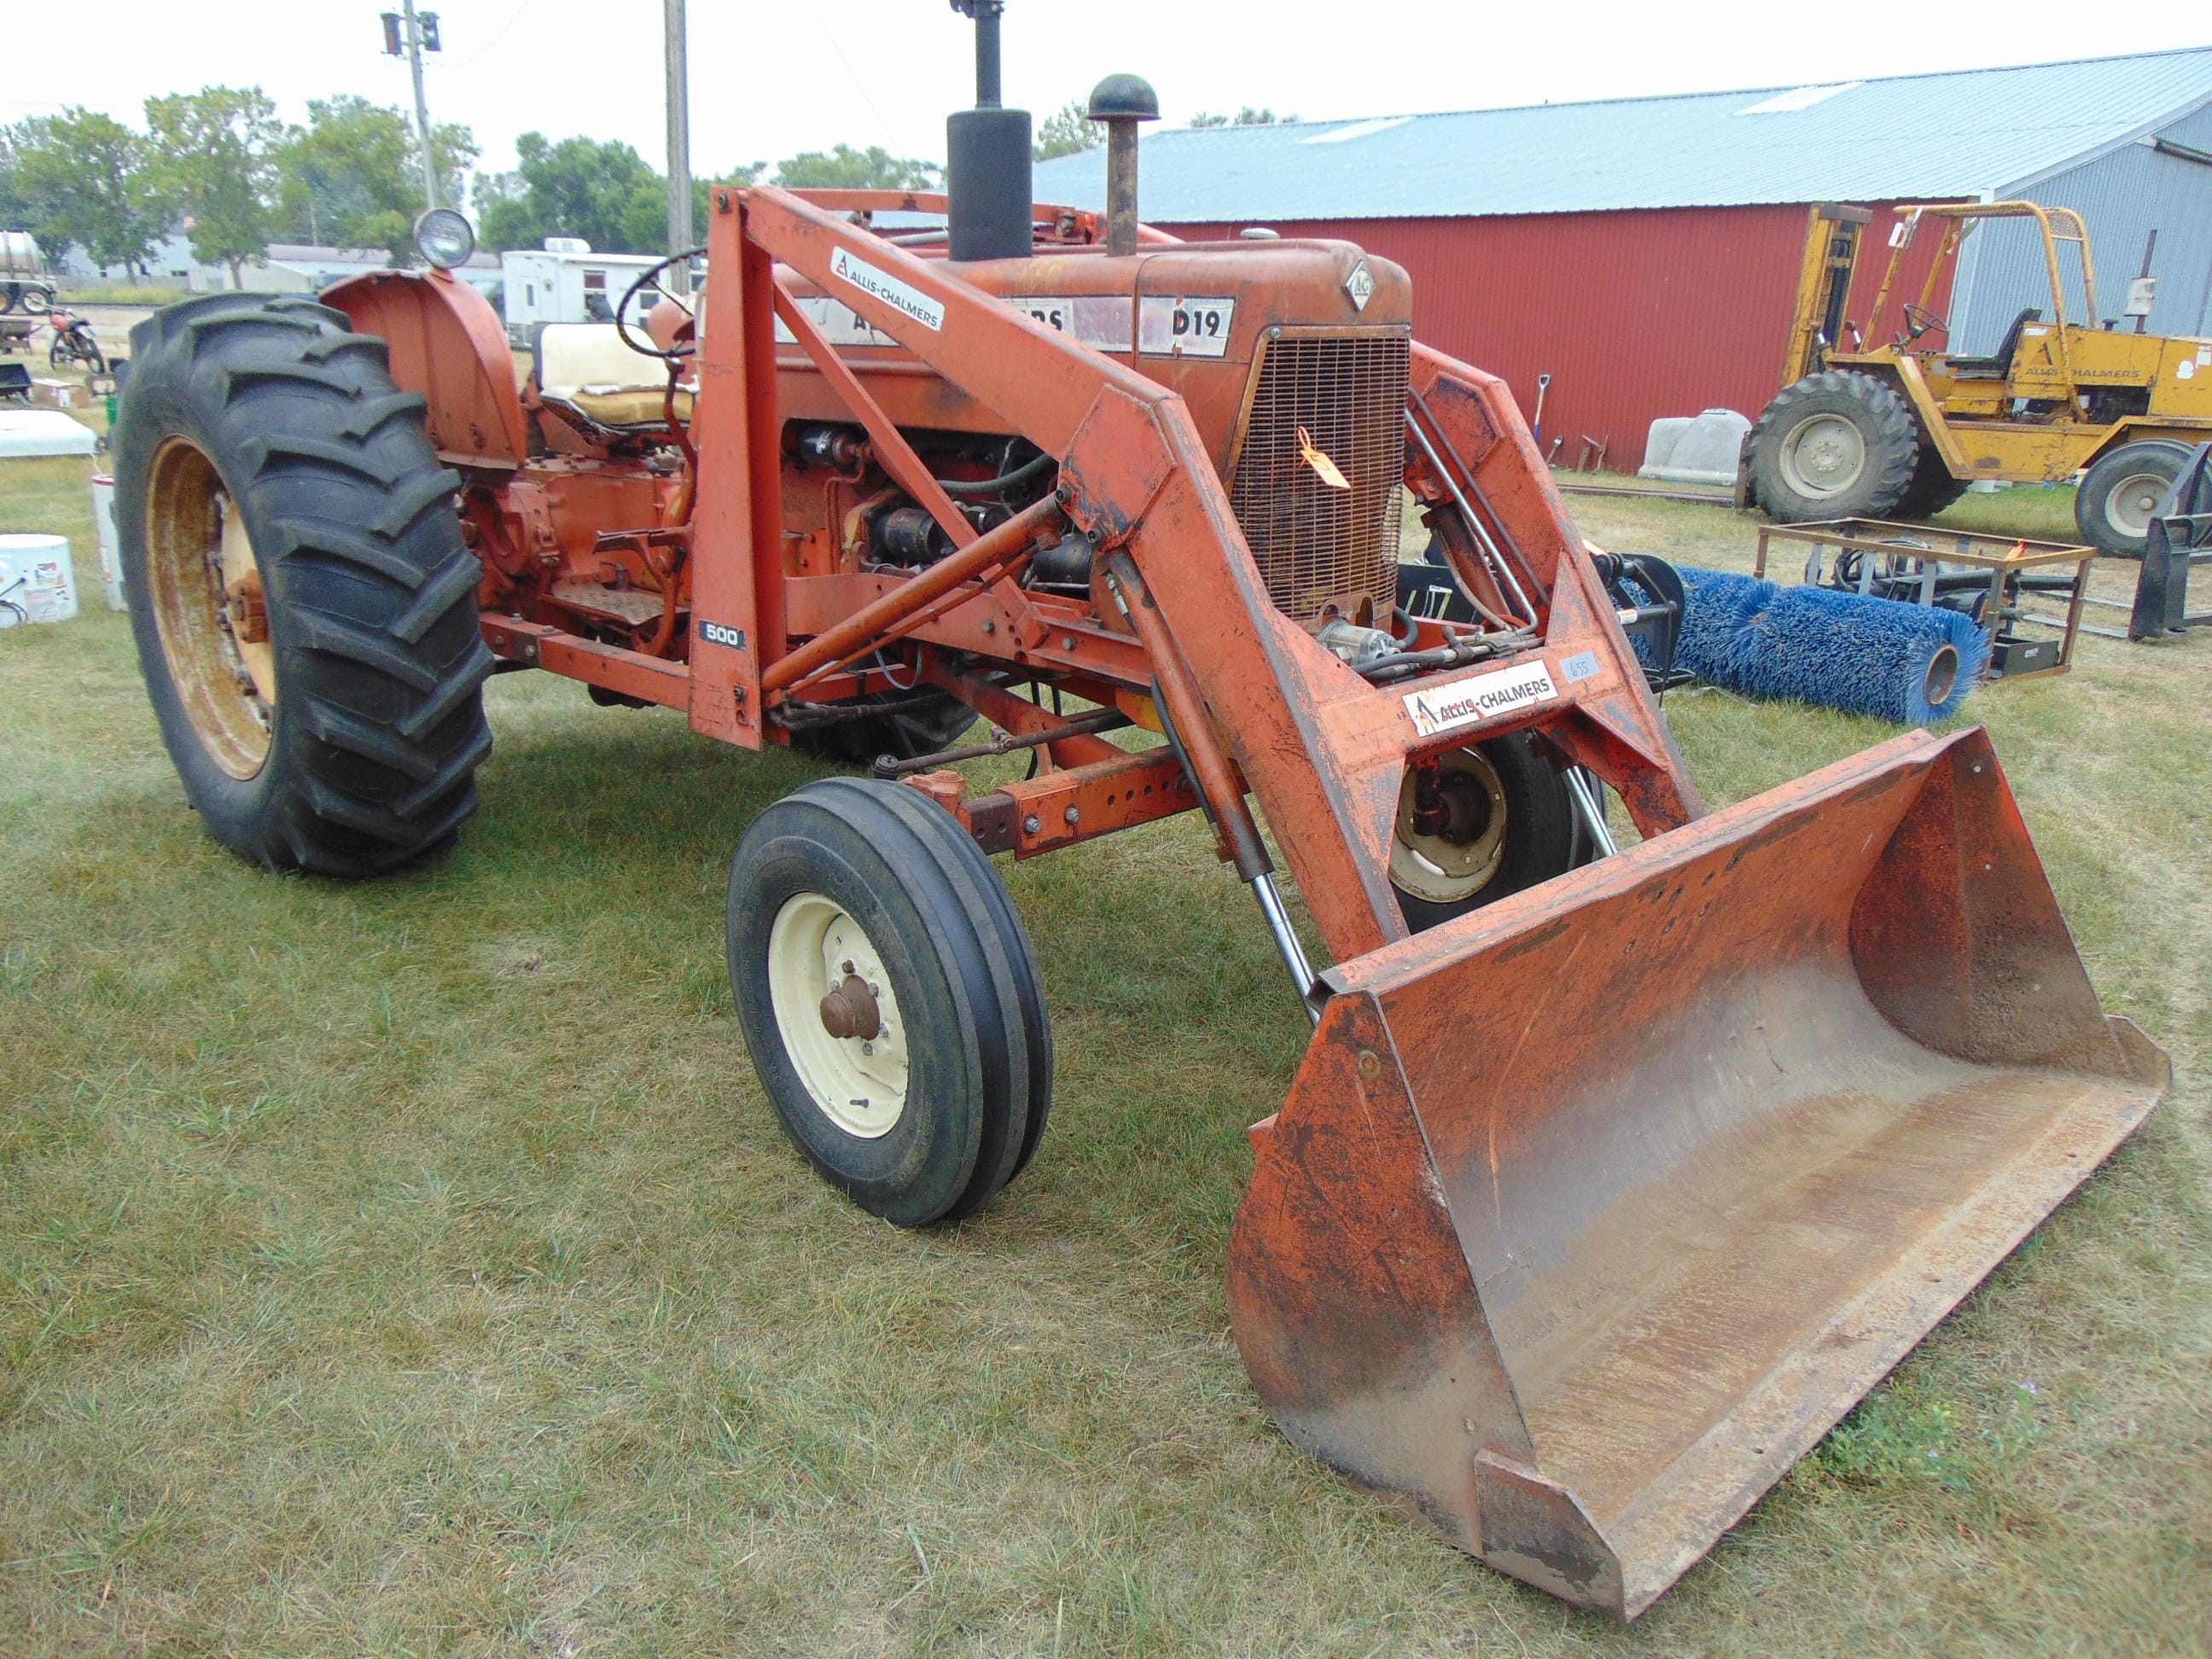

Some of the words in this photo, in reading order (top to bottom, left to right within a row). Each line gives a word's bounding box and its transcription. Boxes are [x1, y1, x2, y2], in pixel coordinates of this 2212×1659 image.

[850, 271, 938, 327] ALLIS-CHALMERS
[2026, 368, 2140, 378] ALLIS-HALMERS
[706, 623, 738, 646] 500
[1440, 678, 1550, 721] ALLIS-CHALMERS
